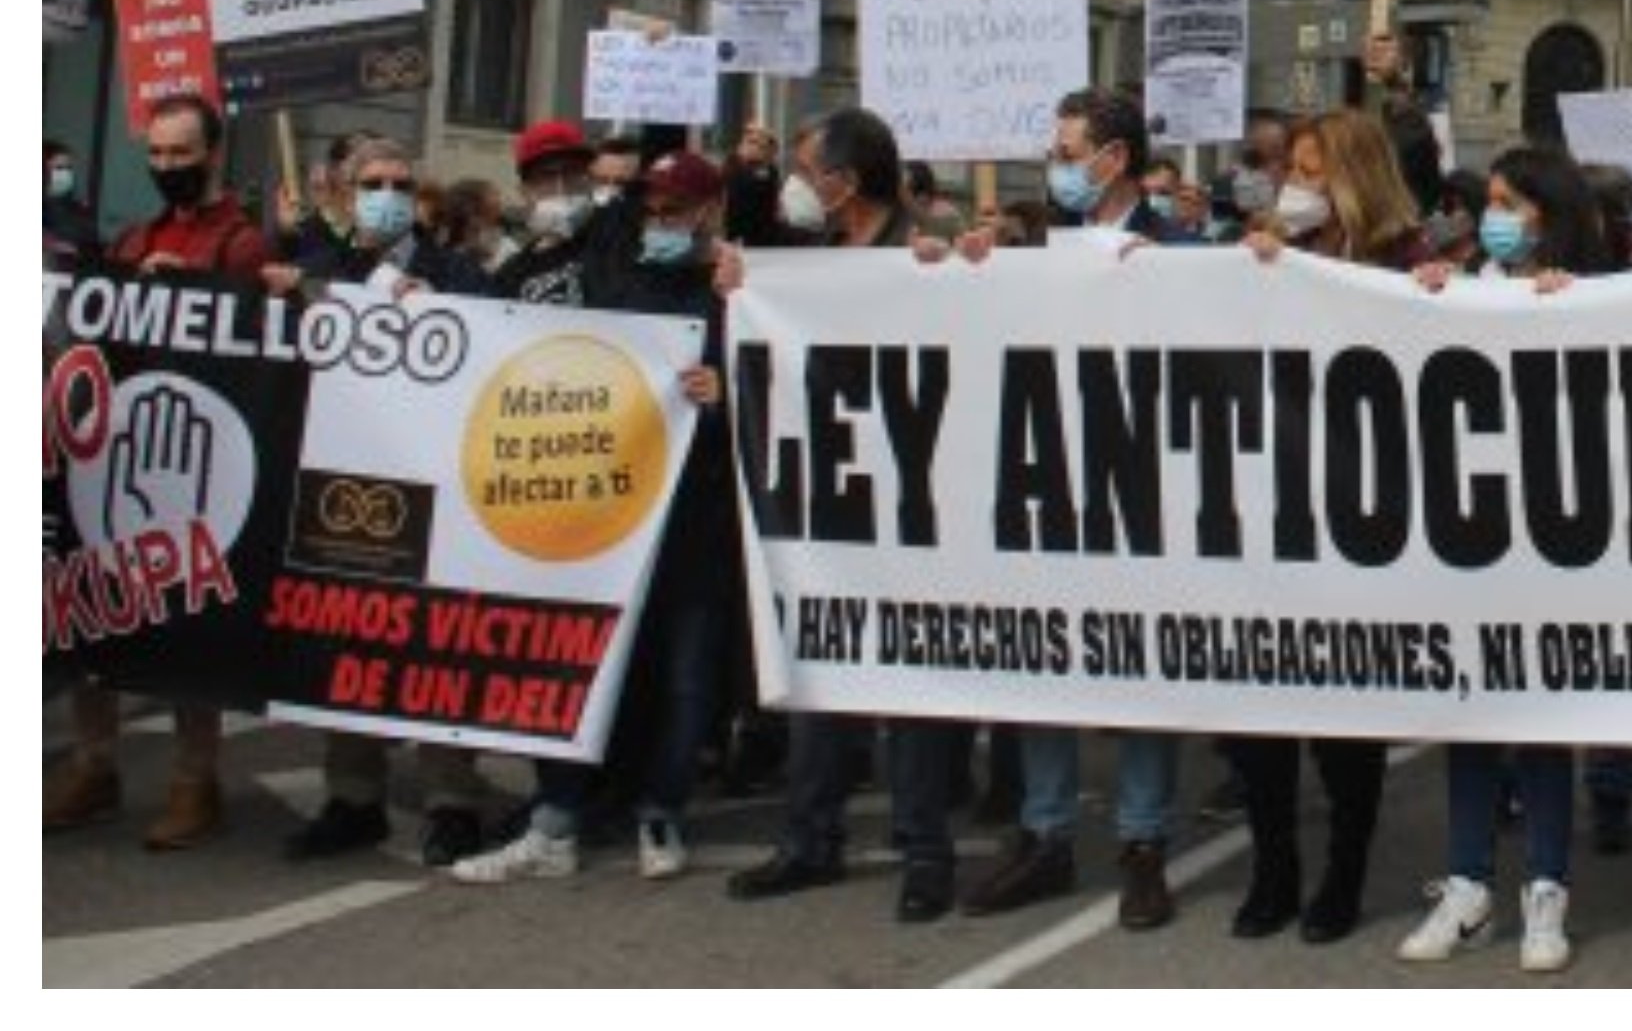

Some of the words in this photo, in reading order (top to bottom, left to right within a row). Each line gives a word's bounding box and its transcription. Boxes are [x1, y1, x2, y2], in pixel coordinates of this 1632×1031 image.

[42, 272, 469, 382] TOMELLOSO
[501, 382, 610, 418] Mañana
[494, 433, 522, 459] te
[530, 423, 615, 467] puede
[737, 342, 951, 548] LEY
[484, 472, 577, 506] afectar
[586, 473, 603, 499] a
[42, 519, 238, 657] KUPA
[268, 574, 417, 646] SOMOS
[797, 596, 868, 662] HAY
[877, 599, 1071, 676] DERECHOS
[1081, 608, 1146, 680] SIN
[1156, 612, 1471, 700] OBLIGACIONES,
[1479, 622, 1528, 693] NI
[330, 653, 388, 707] DE
[400, 663, 470, 718] UN
